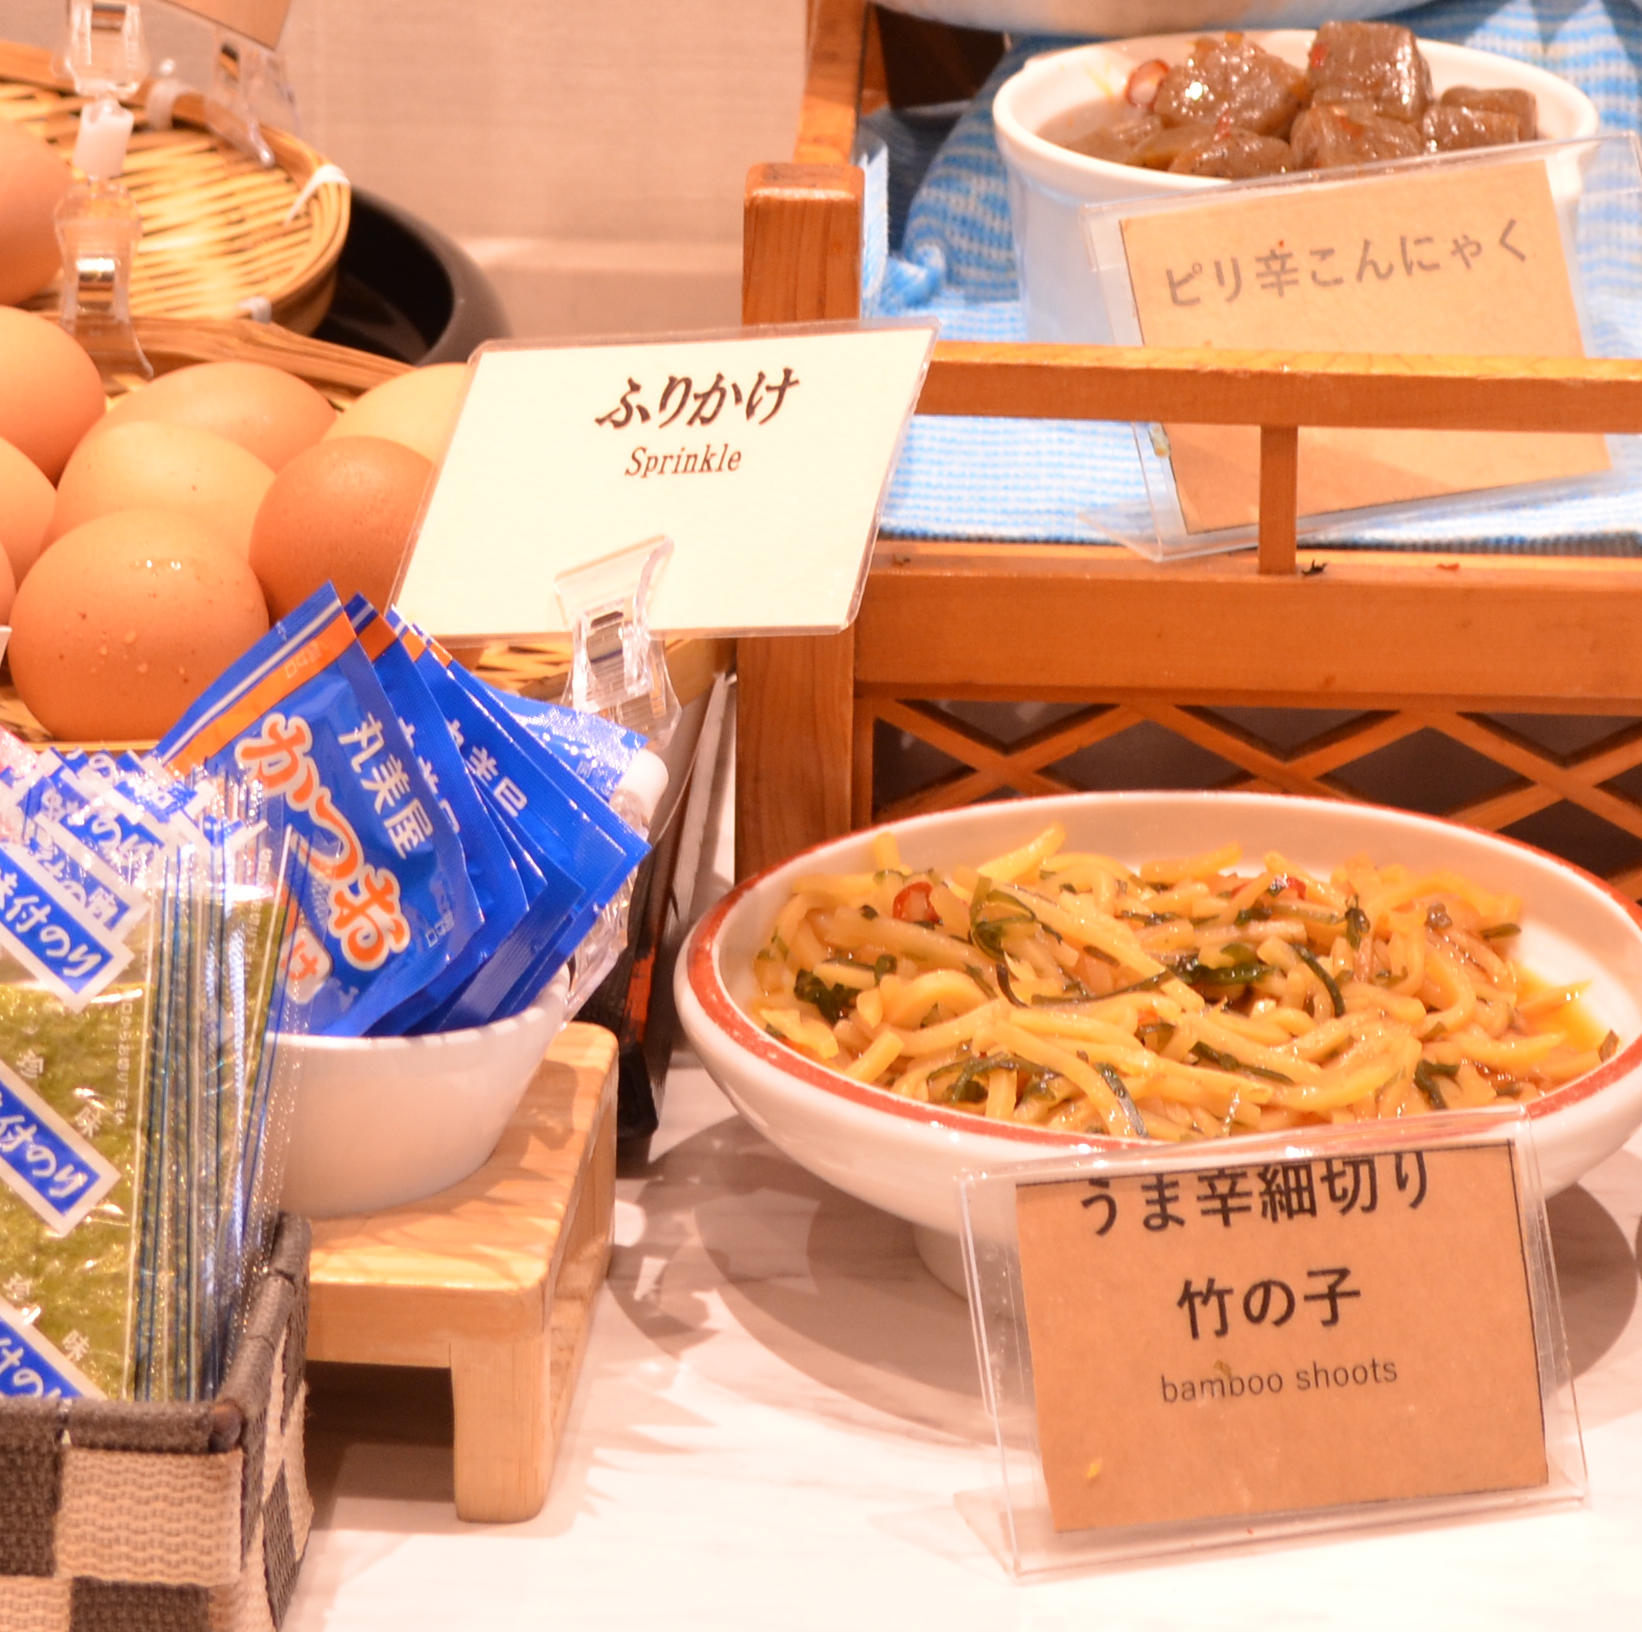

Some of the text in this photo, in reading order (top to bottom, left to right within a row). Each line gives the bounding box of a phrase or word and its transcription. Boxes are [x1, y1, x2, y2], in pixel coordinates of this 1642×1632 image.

[1165, 218, 1527, 308] ピリ辛こんにゃく
[595, 368, 800, 429] ふりかけ
[624, 443, 742, 478] Sprinkle
[338, 711, 434, 860] 丸美屋
[1080, 1151, 1427, 1236] うま辛細切り
[1177, 1266, 1361, 1340] 竹の子
[1161, 1357, 1399, 1405] bamboo shoots
